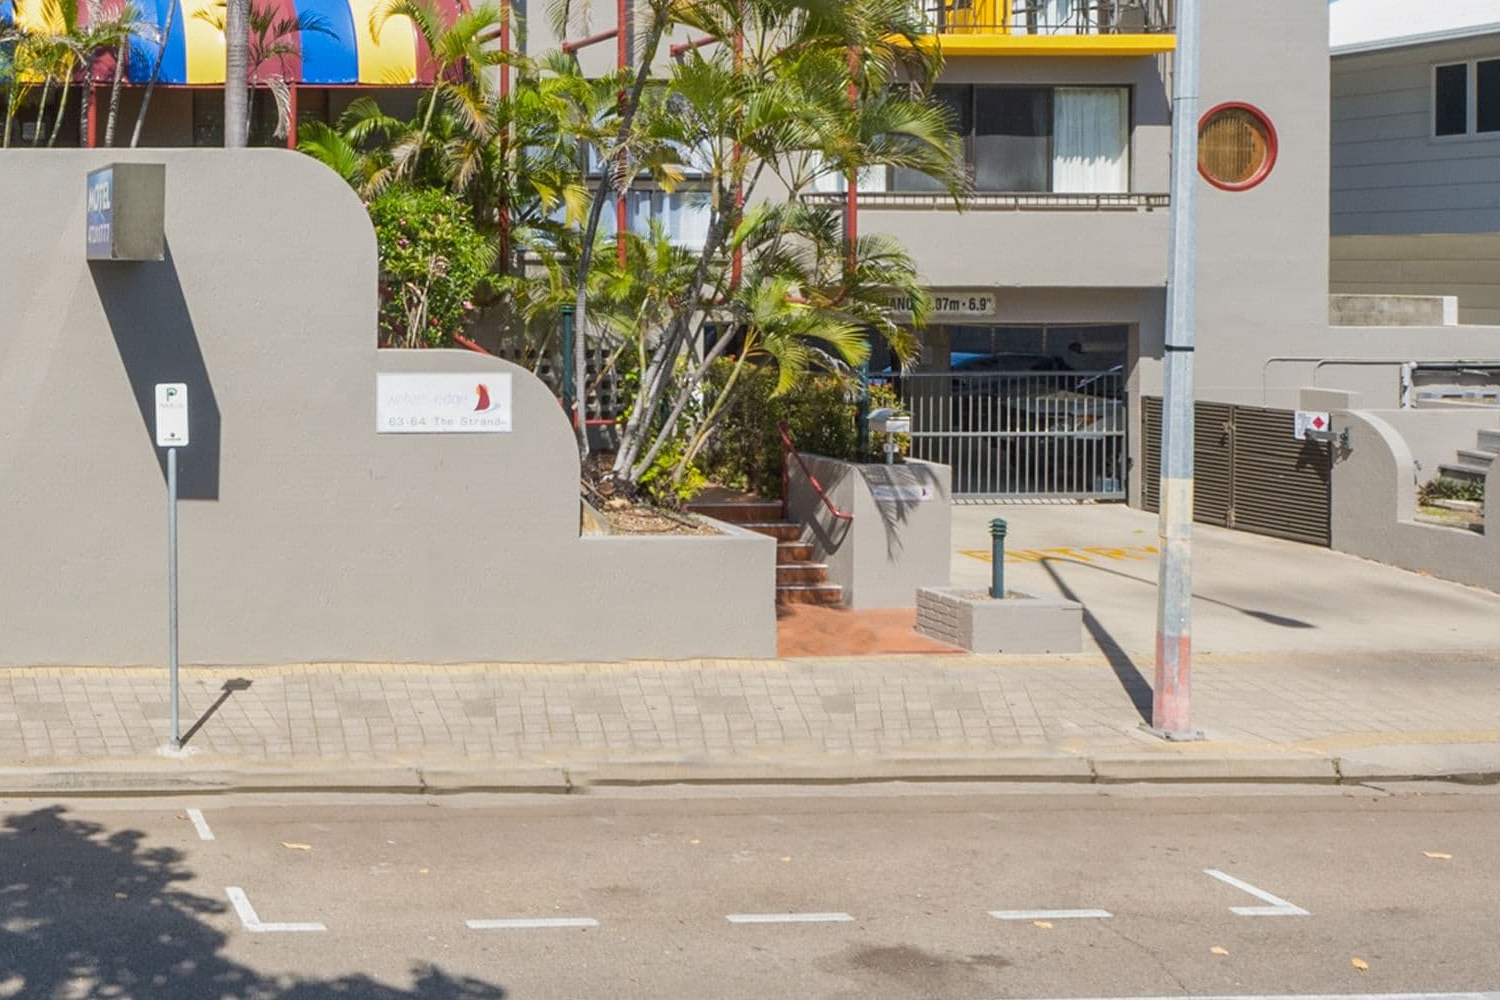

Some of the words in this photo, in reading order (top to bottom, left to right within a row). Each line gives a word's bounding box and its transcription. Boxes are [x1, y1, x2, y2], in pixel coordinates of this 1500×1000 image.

[88, 182, 111, 212] MOTEL
[166, 387, 178, 402] P
[434, 416, 454, 427] The
[460, 416, 502, 427] Strand
